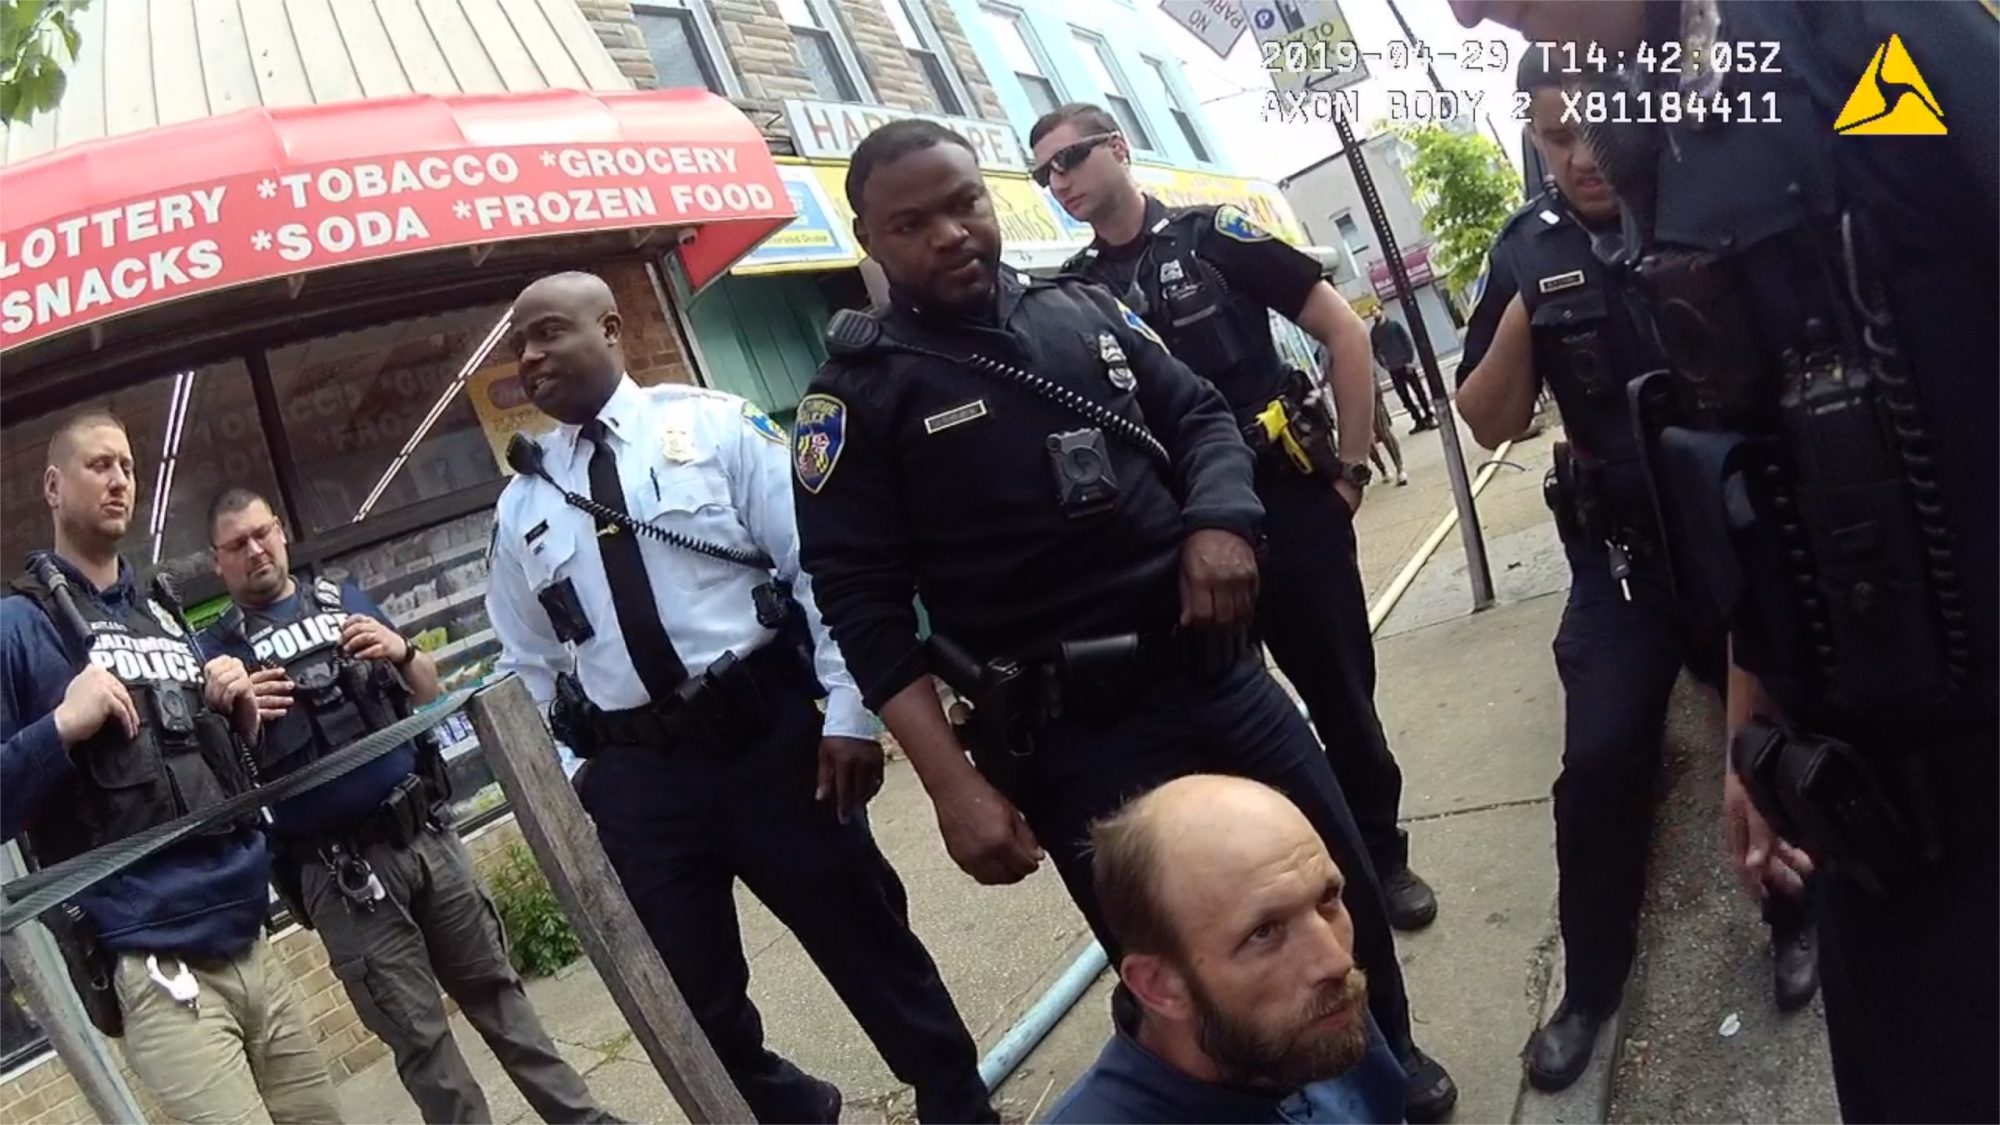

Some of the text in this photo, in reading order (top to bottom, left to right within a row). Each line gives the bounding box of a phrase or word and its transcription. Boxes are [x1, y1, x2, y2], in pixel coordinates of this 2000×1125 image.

[1188, 9, 1212, 34] NO
[1308, 21, 1334, 42] TO
[803, 106, 1013, 165] HARE
[0, 186, 226, 280] LOTTERY
[0, 238, 224, 334] SNACKS
[671, 184, 774, 212] FOOD
[88, 649, 205, 684] POLICE
